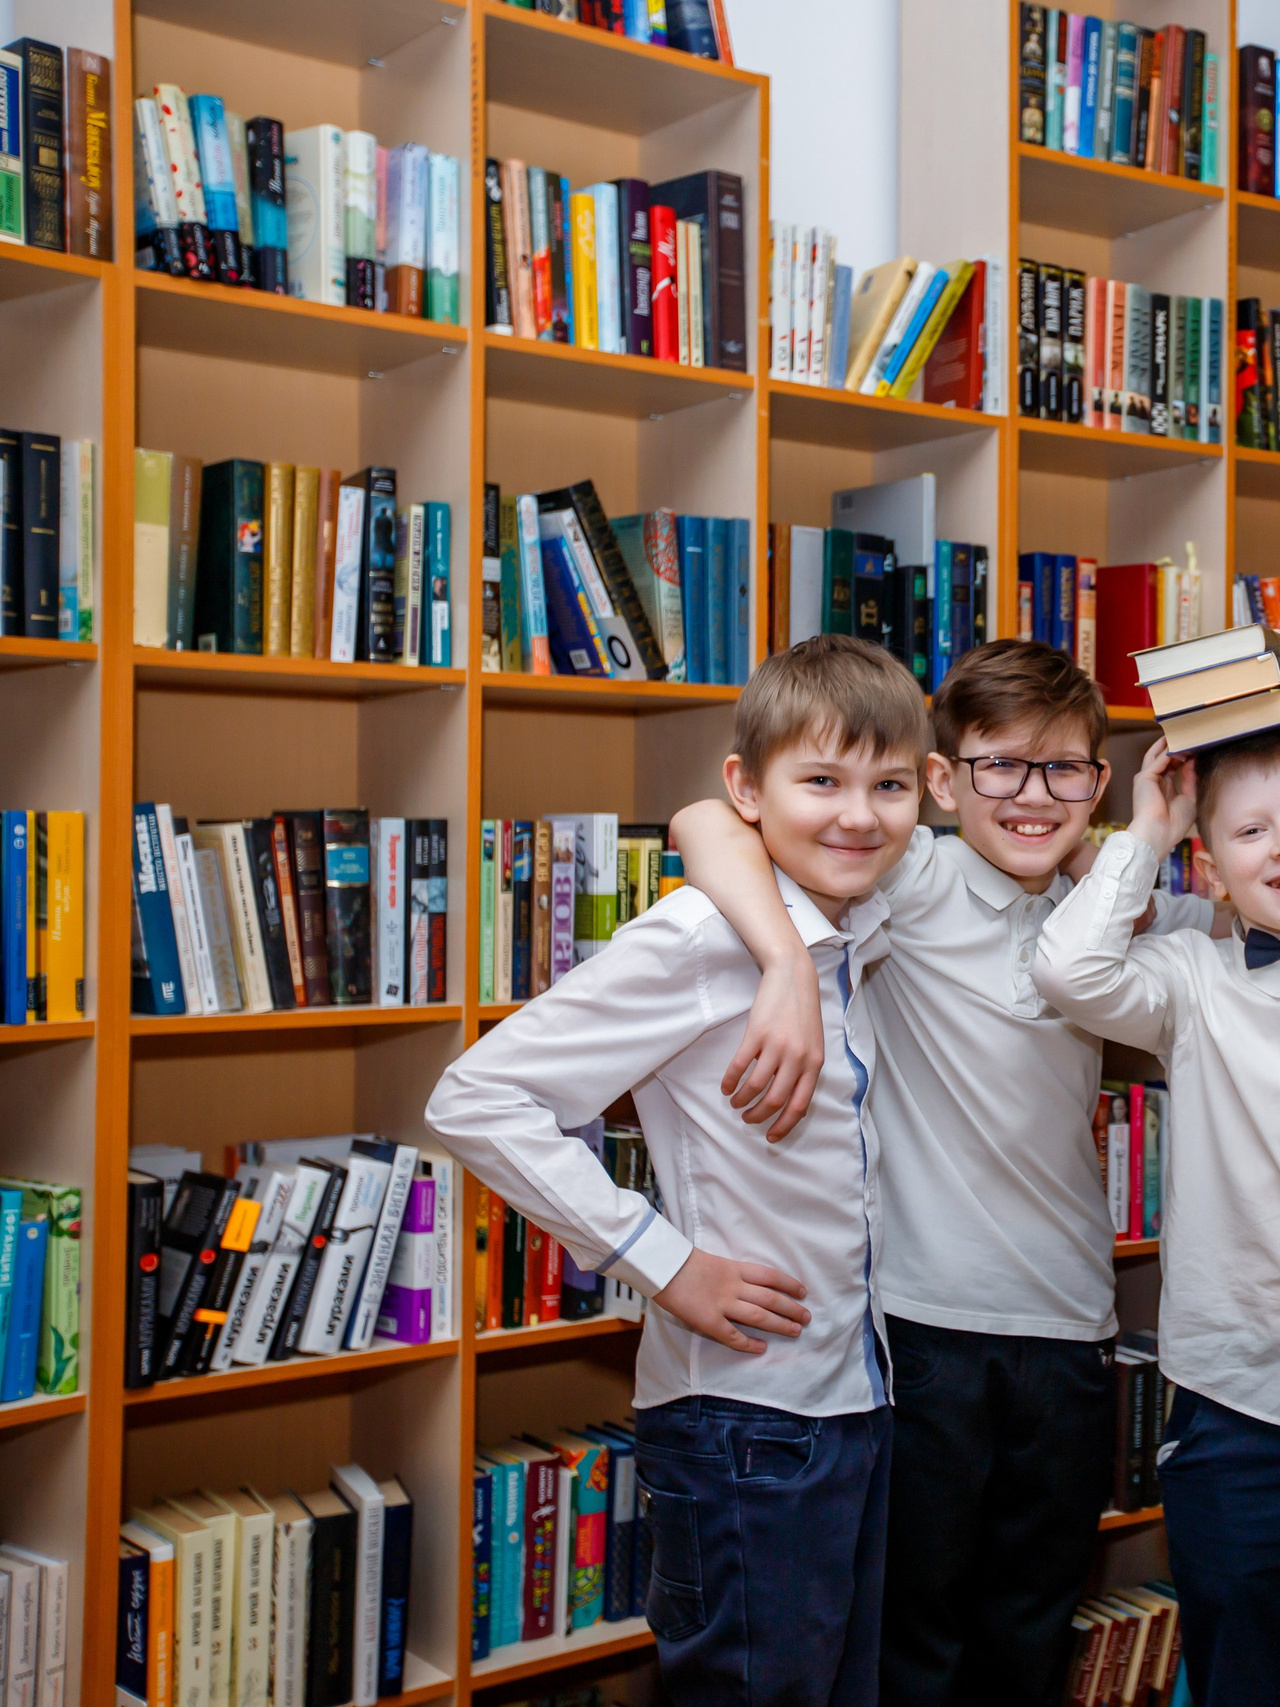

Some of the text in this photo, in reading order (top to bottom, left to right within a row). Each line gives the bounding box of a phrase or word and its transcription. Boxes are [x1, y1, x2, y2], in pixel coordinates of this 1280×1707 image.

[77, 107, 109, 188] Маккалоу
[630, 266, 653, 317] Александр
[1068, 288, 1083, 336] ПАРИЖ
[1153, 309, 1168, 363] РЕМАРК
[135, 814, 155, 893] Москва:
[154, 858, 165, 891] МЕСТО
[616, 851, 626, 891] ОРУЭЛЛ
[647, 852, 659, 891] ОРУЭЛЛ
[347, 1175, 367, 1215] Хроники
[367, 1169, 409, 1290] ЗИМНЯЯ БИТВА
[136, 1276, 155, 1348] МУРАКАМИ
[173, 1272, 206, 1336] МУРАКАМИ
[221, 1265, 260, 1351] мураками
[252, 1261, 293, 1346] мураками
[290, 1256, 320, 1317] МУРАКАМИ
[320, 1253, 360, 1338] мураками
